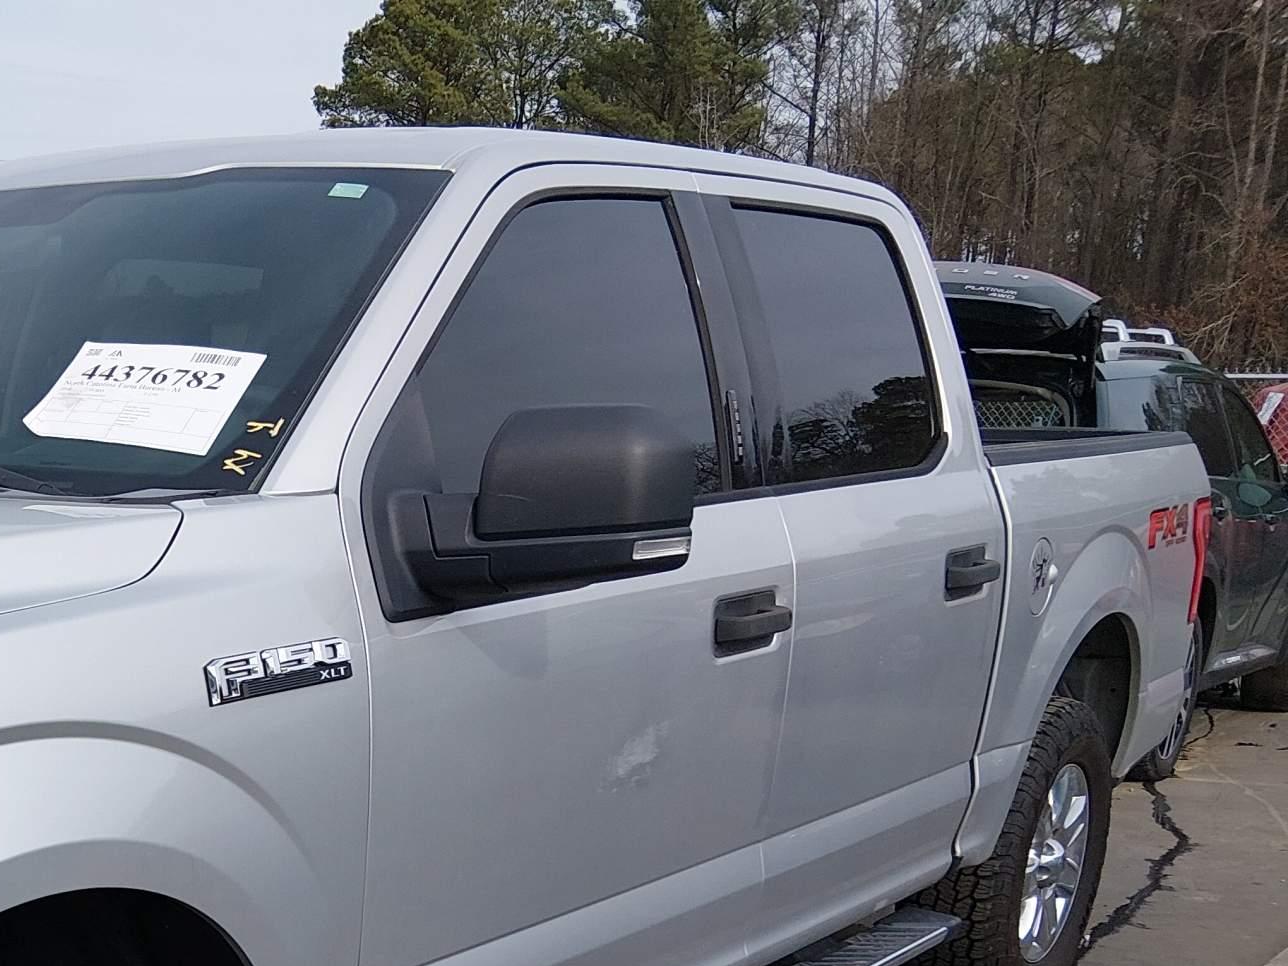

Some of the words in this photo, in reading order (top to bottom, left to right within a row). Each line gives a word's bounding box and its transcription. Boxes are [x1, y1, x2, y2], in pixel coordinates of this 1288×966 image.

[964, 284, 1018, 296] PLATINUM
[81, 364, 226, 390] 44376782
[1148, 503, 1189, 550] FX4
[319, 666, 348, 681] XLT
